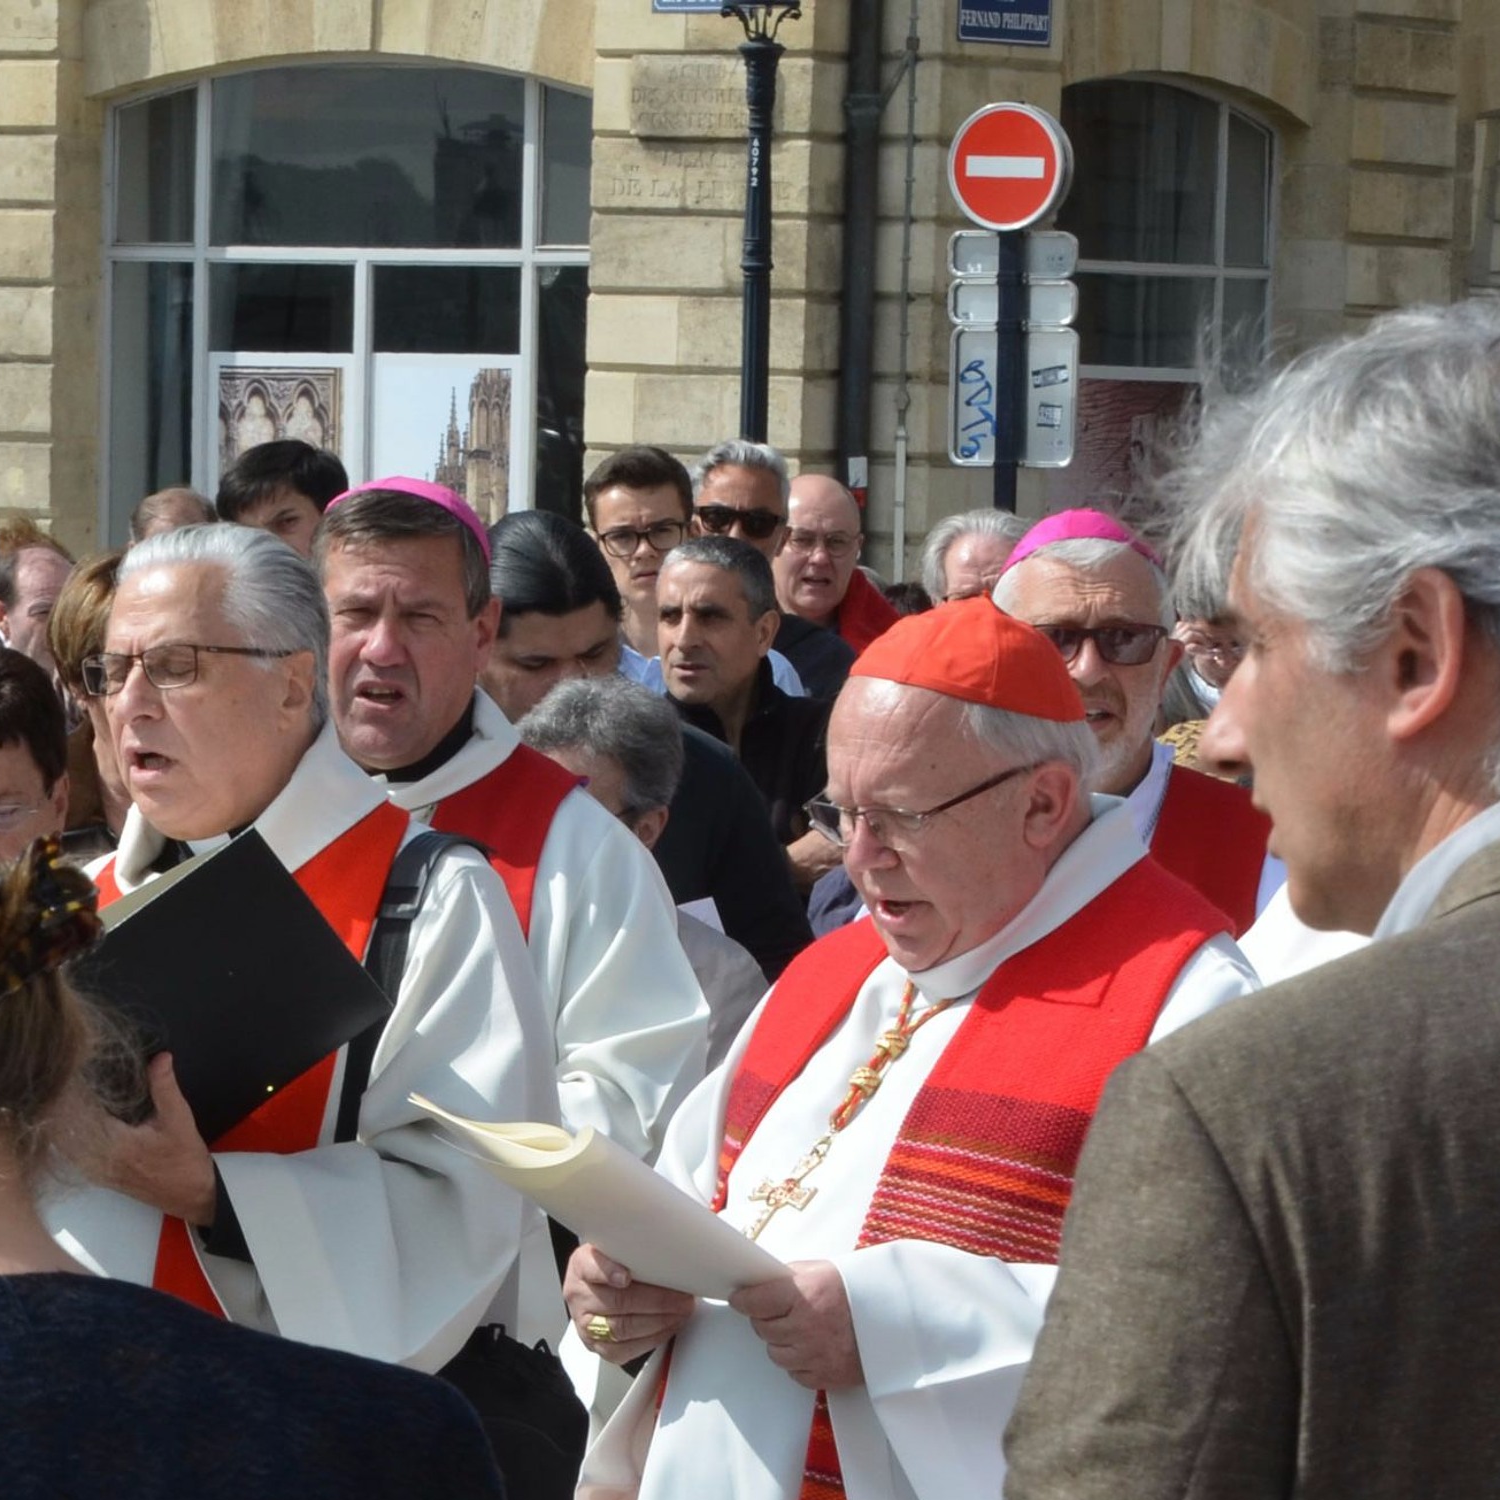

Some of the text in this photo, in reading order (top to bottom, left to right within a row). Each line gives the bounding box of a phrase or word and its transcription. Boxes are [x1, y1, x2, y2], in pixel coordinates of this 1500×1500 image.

[960, 9, 1000, 28] FERNAND
[610, 178, 642, 198] DE
[650, 179, 678, 199] LA
